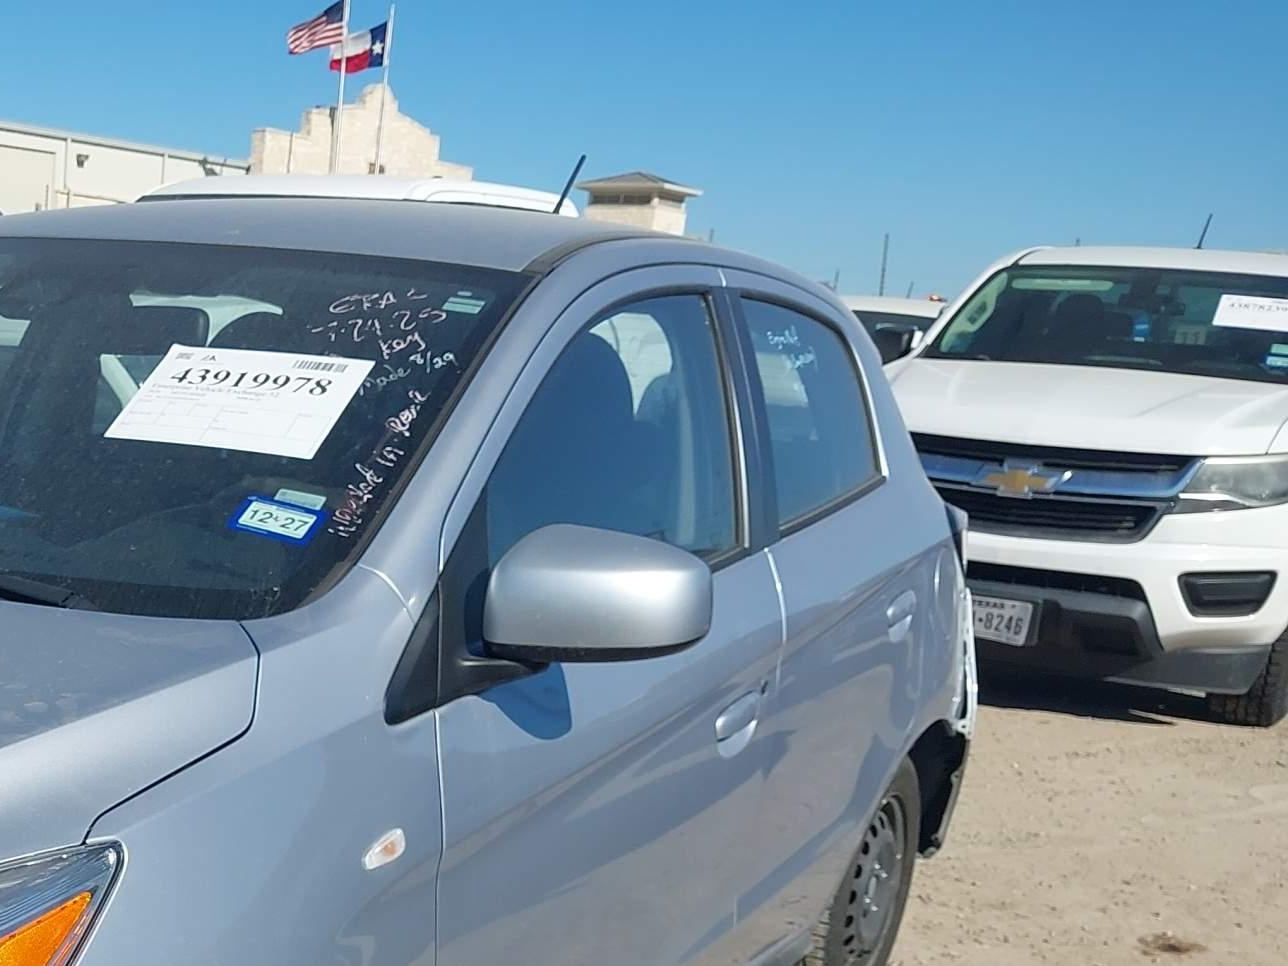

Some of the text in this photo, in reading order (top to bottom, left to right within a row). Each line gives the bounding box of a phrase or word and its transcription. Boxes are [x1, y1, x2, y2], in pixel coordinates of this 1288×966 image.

[171, 366, 333, 397] 43919978
[249, 509, 309, 532] 12 27
